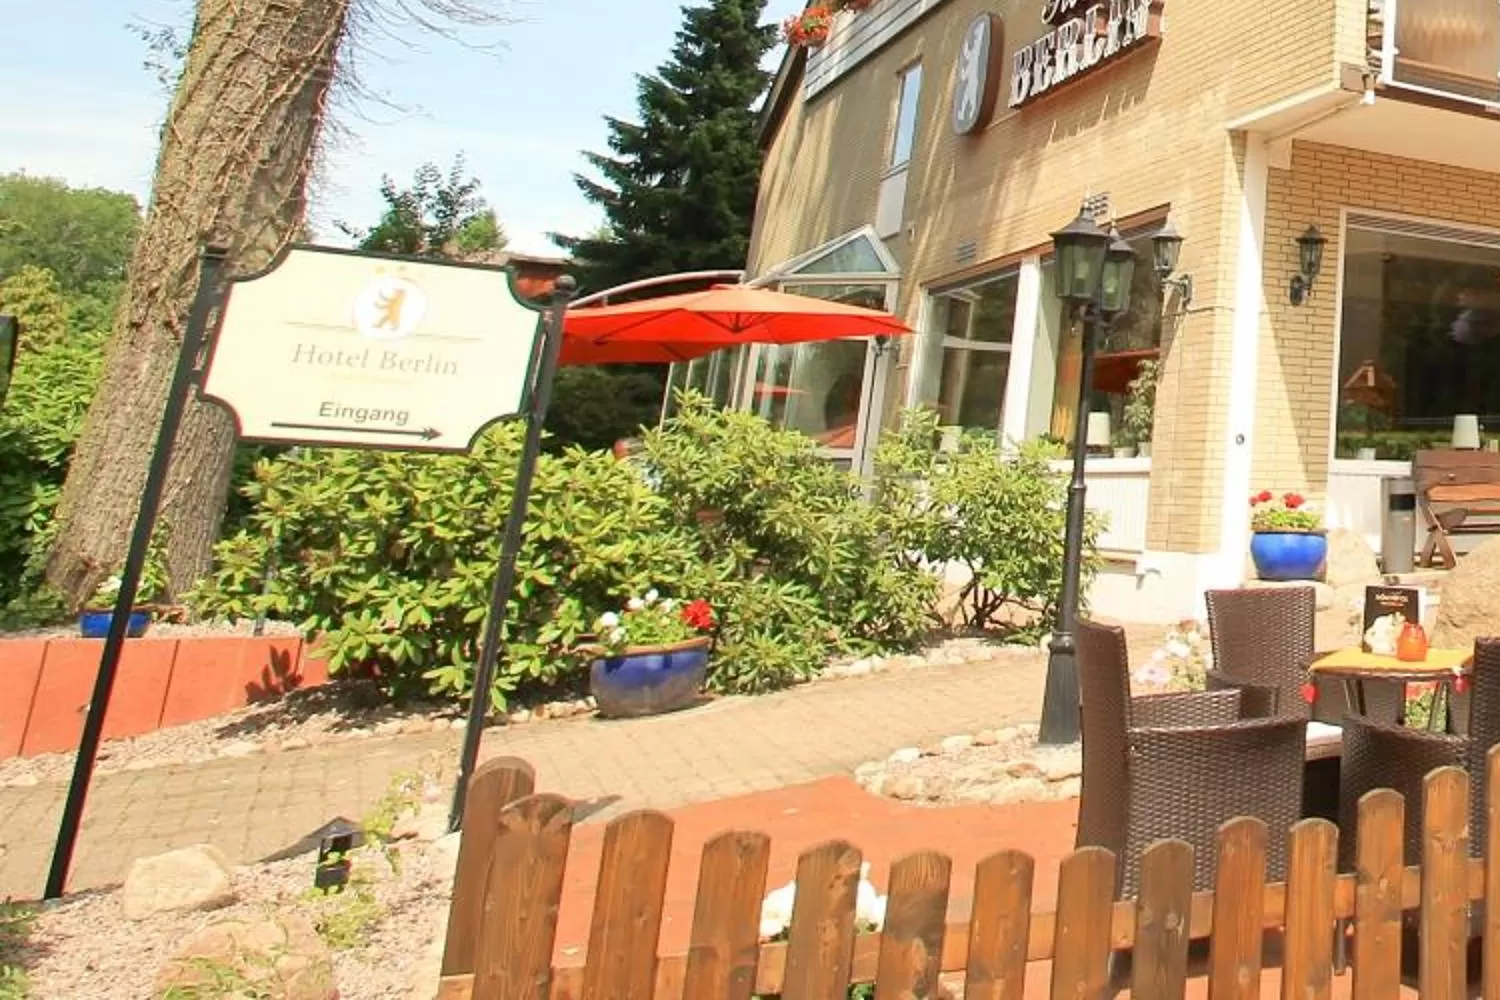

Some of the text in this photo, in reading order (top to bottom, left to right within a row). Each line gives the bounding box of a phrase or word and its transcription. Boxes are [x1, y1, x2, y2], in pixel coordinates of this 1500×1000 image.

[292, 343, 458, 375] Hotel Berlin
[319, 401, 410, 425] Eingang
